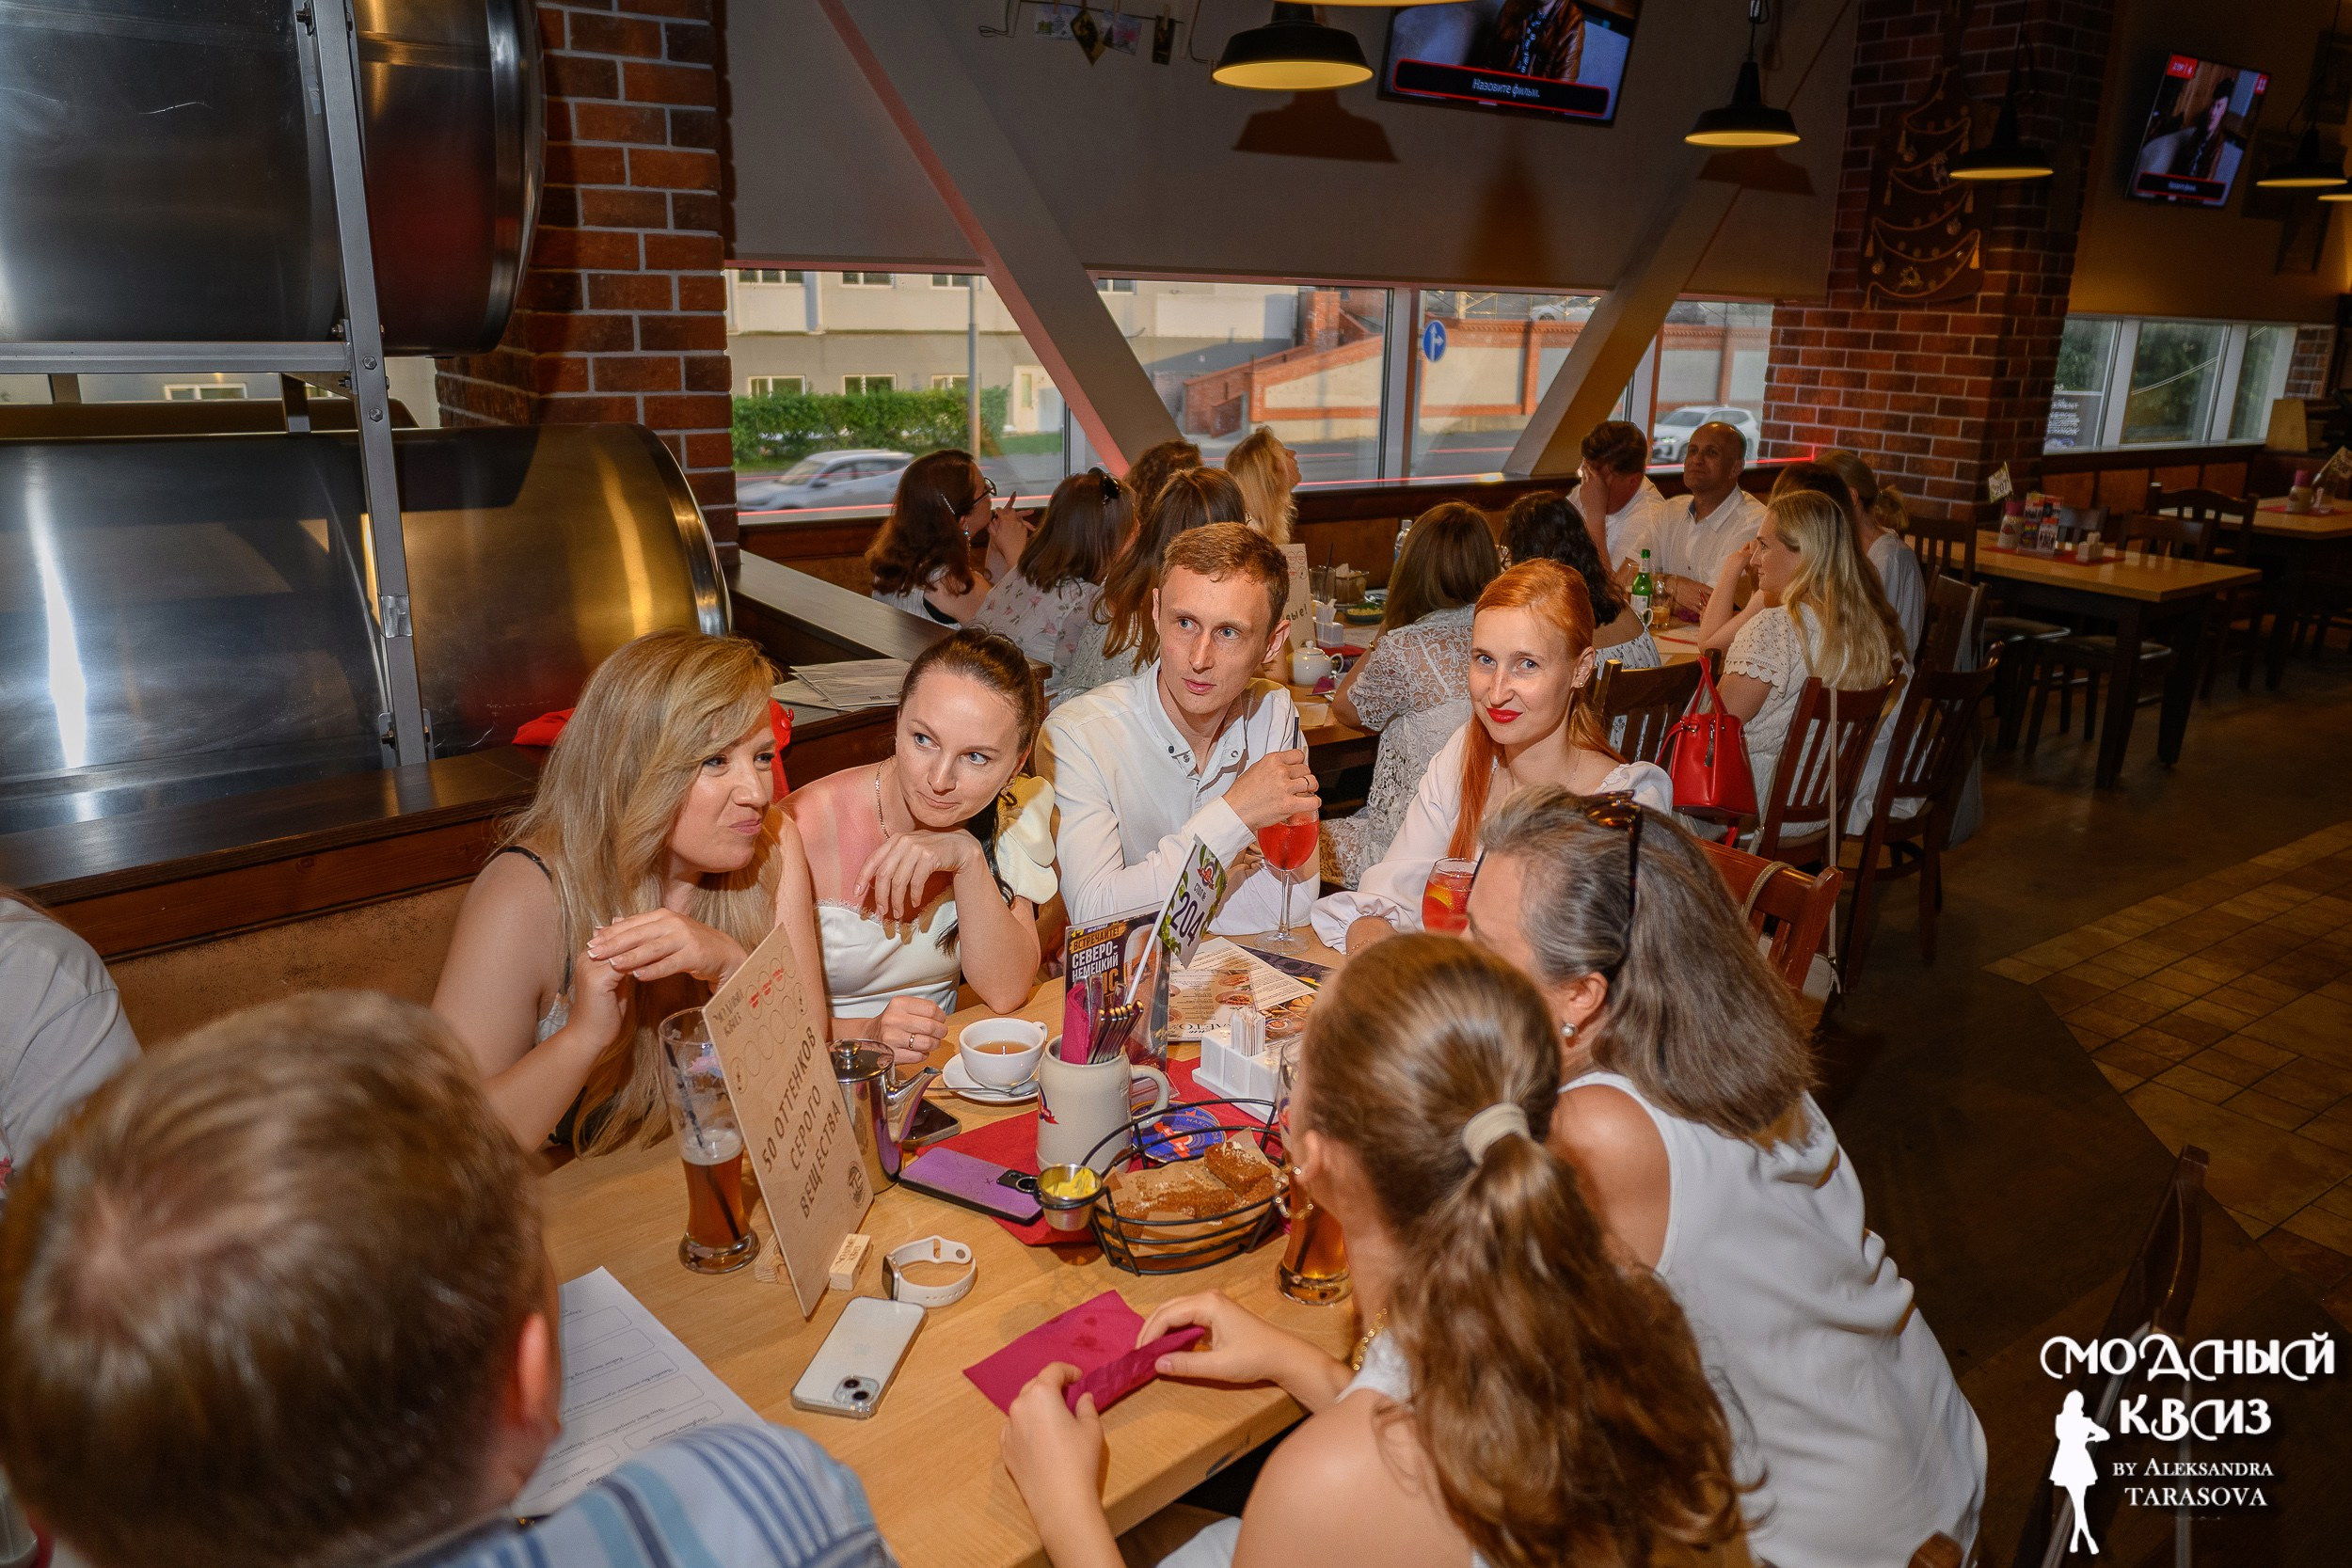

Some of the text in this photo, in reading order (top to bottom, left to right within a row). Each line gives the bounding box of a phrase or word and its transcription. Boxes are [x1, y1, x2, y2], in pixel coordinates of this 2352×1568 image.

[1472, 77, 1540, 98] Назовите фильм.
[1073, 926, 1120, 951] ВСТРЕЧАЙТЕ!
[1170, 891, 1205, 947] 204
[1073, 941, 1119, 969] СЕВЕРО-
[1073, 952, 1119, 982] НЕМЕЦКИЙ
[775, 1025, 817, 1142] ОТТЕНКОВ
[789, 1085, 821, 1172] СЕРОГО
[800, 1104, 841, 1220] ВЕЩЕСТВА
